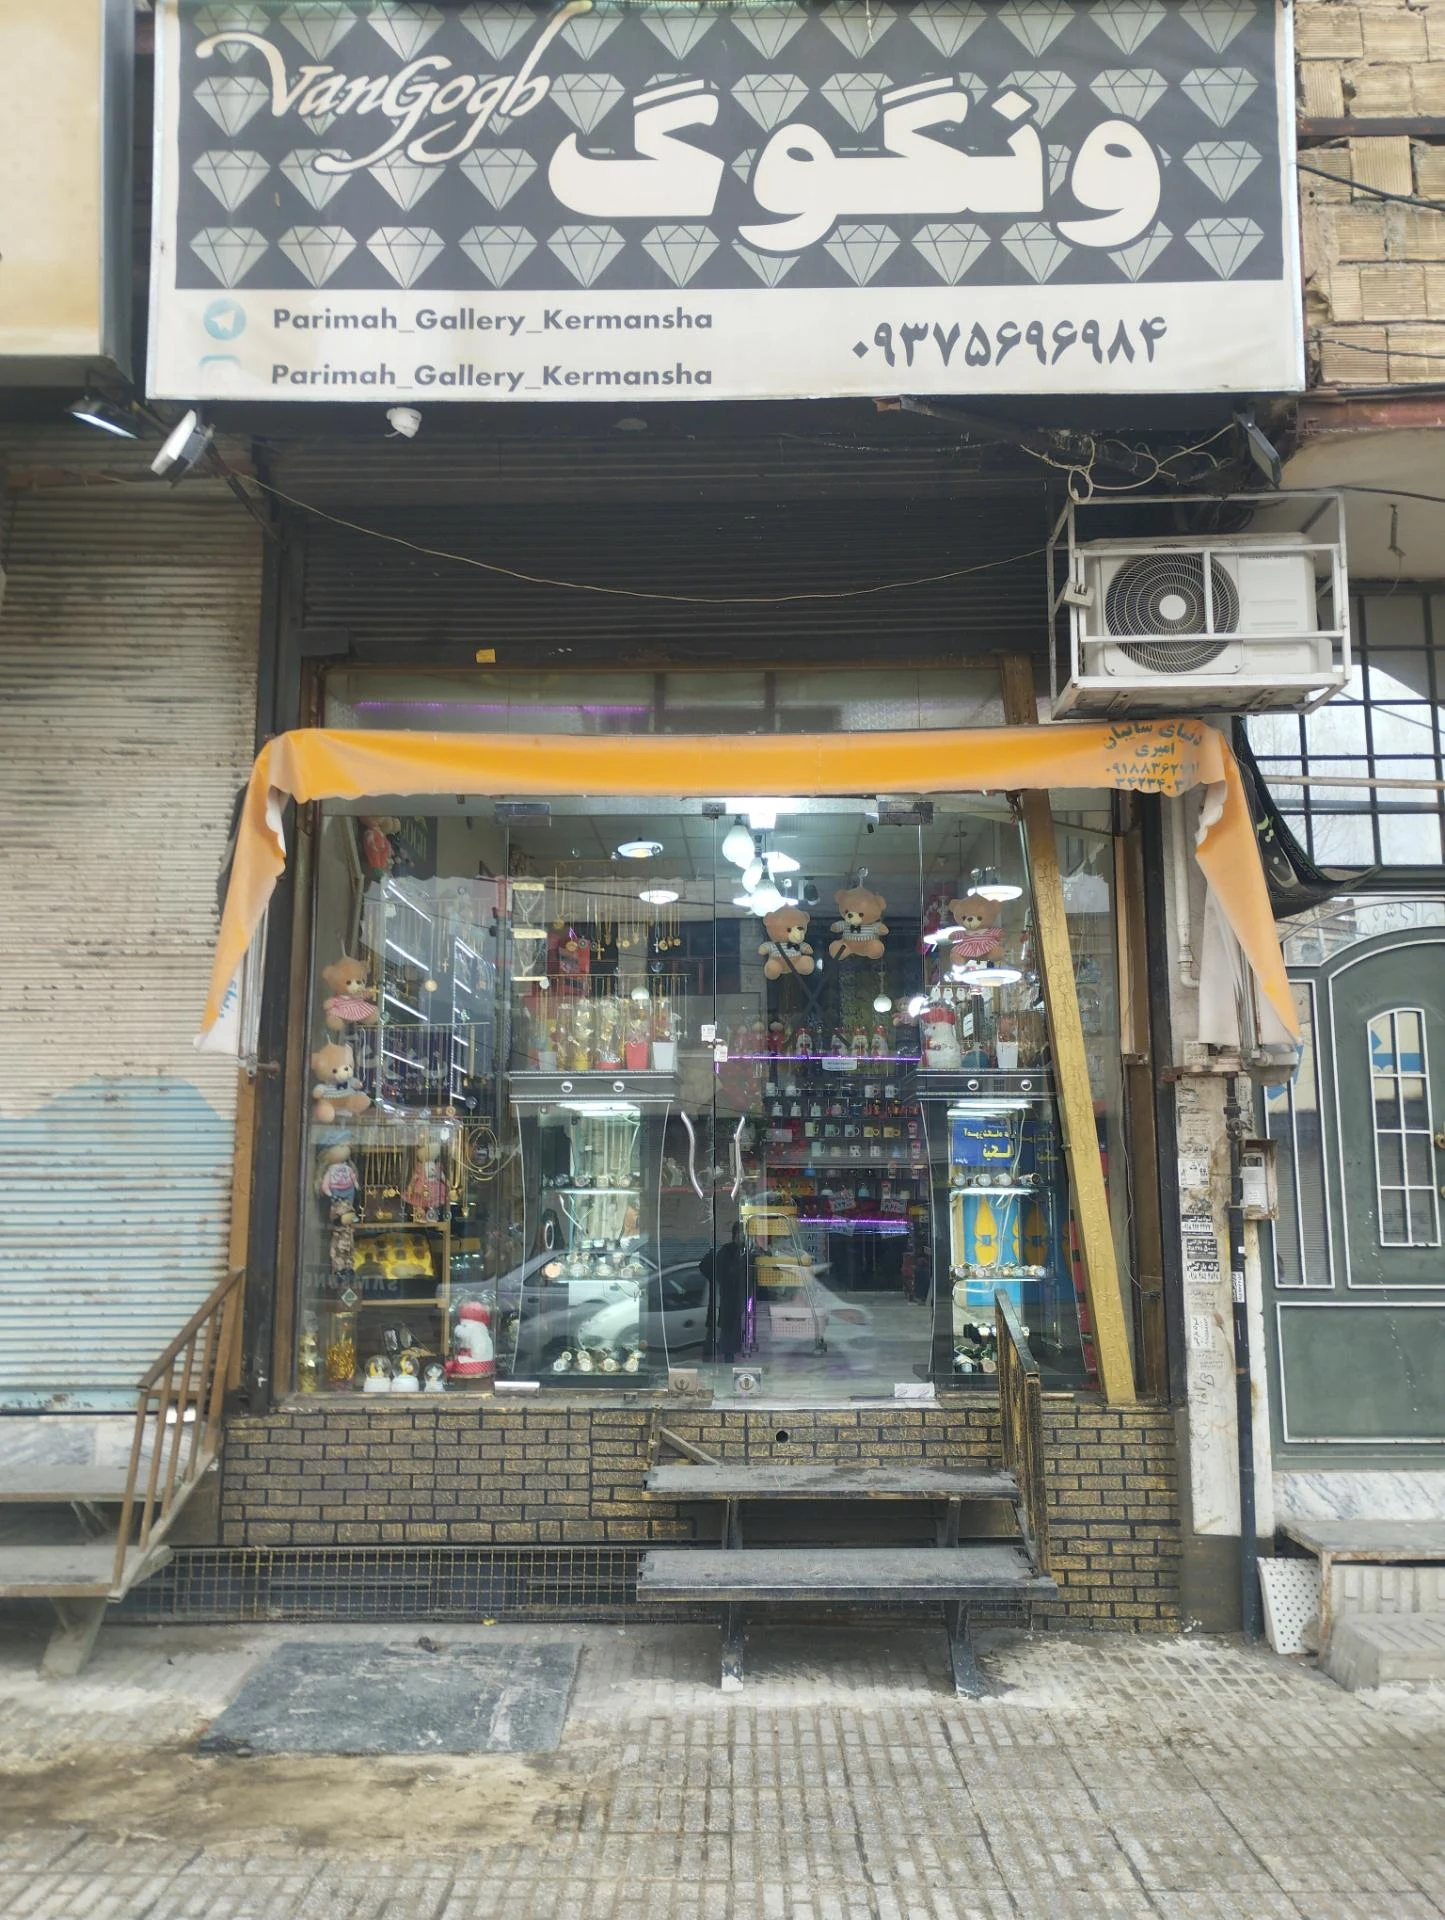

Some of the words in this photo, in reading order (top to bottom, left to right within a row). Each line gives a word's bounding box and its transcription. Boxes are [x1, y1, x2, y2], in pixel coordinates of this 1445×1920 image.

[549, 77, 1160, 250] ونگوگ
[274, 308, 712, 336] Parimah_Gallery_Kermansha
[852, 315, 1167, 367] ۰۹۳۷۵۶۹۶۹۸۴
[271, 363, 712, 391] Parimah_Gallery_Kermansha
